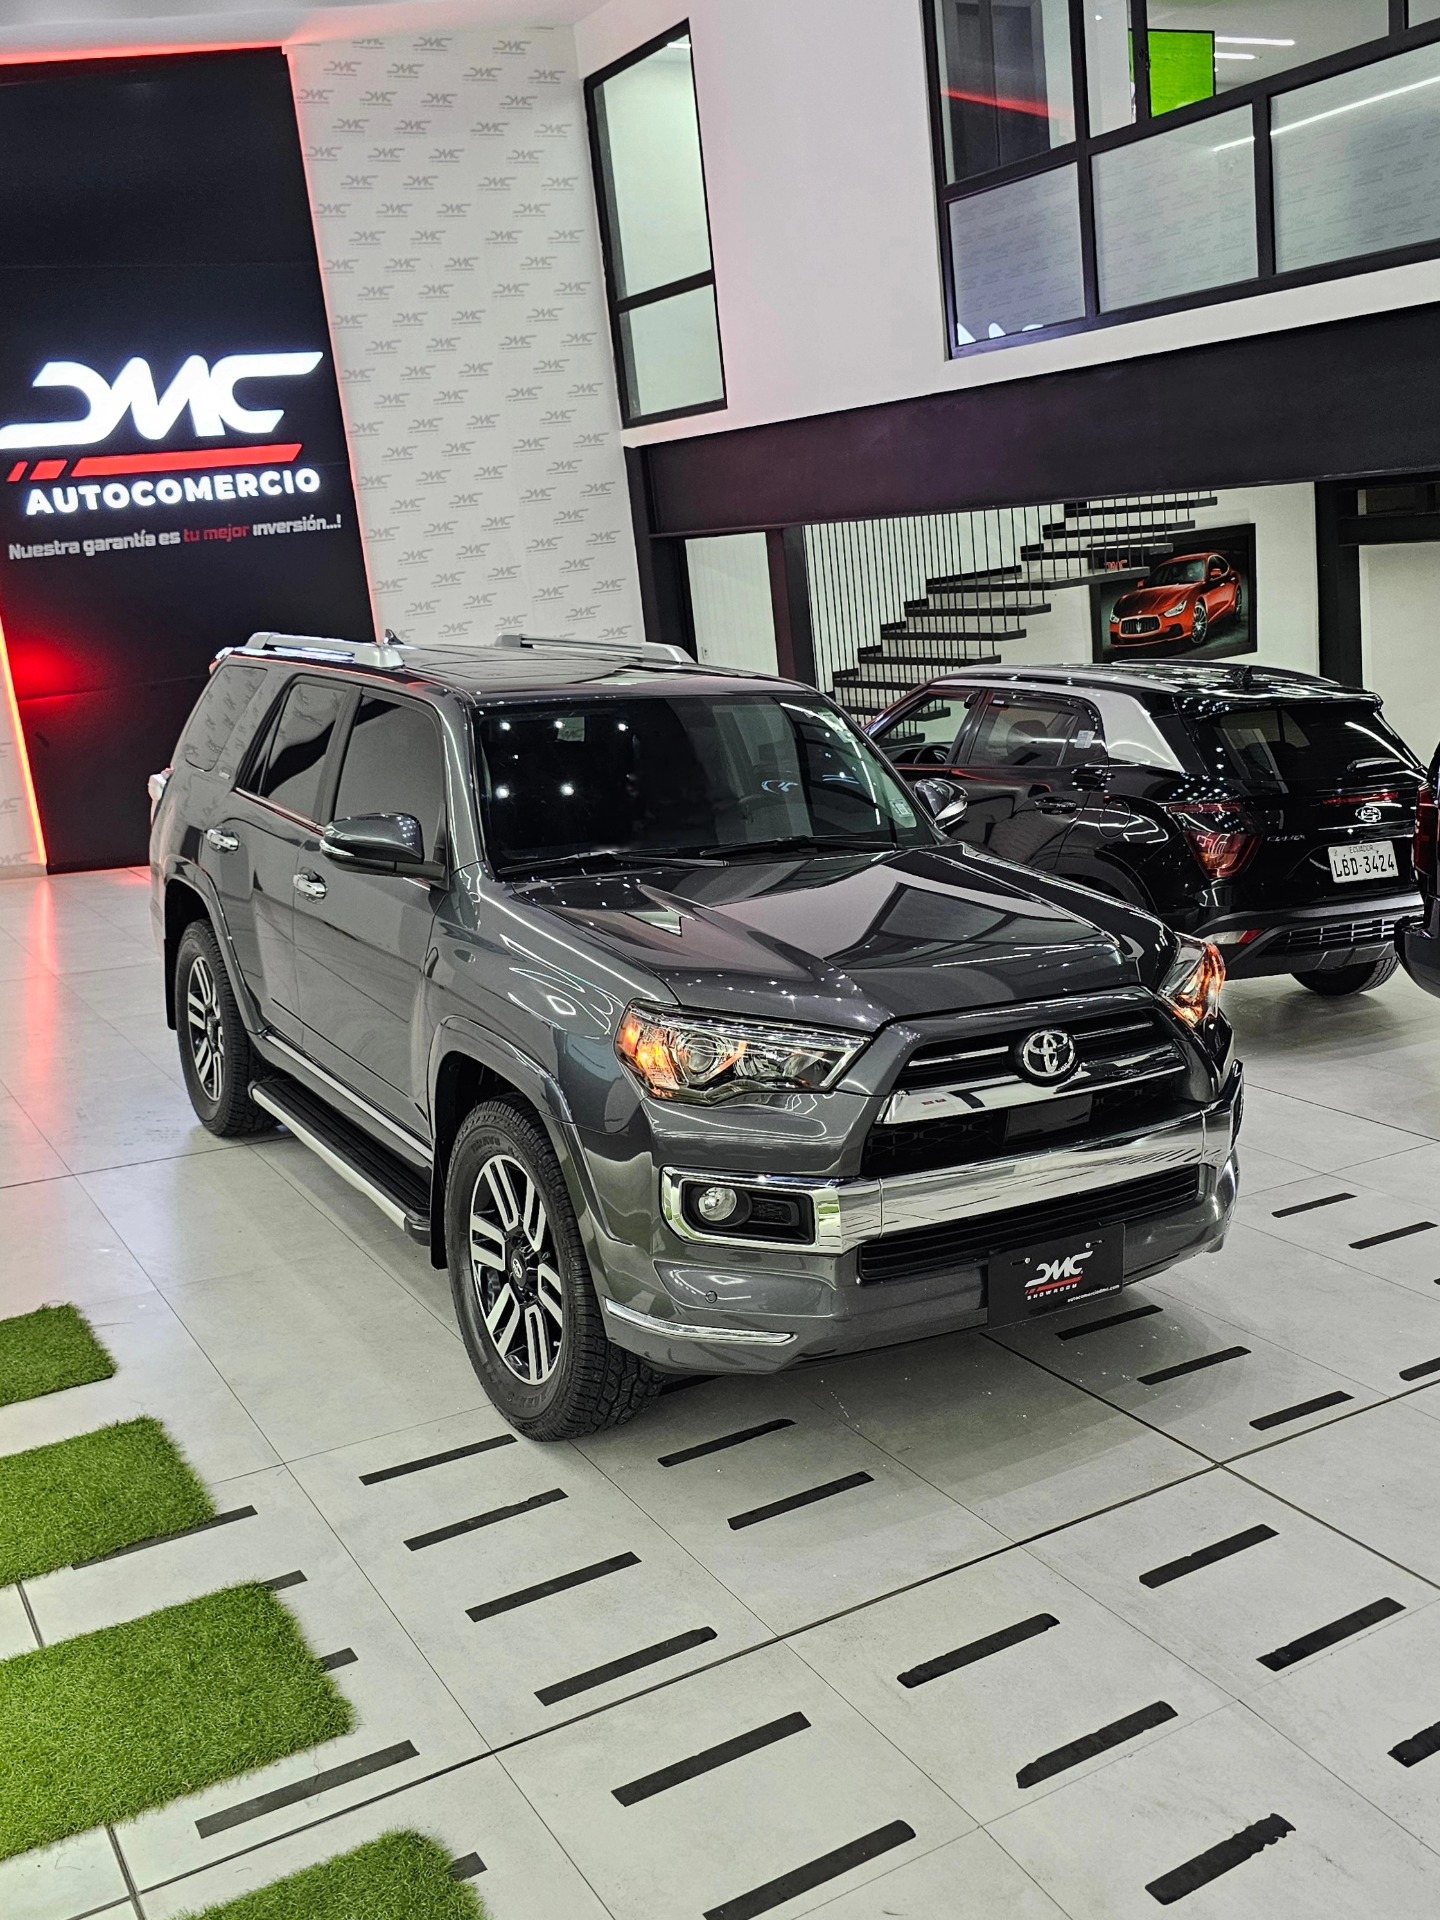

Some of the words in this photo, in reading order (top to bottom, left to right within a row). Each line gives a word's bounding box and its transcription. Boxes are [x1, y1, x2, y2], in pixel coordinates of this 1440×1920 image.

[412, 36, 452, 48] DMC
[492, 40, 531, 51] DMC
[324, 61, 362, 72] DMC
[387, 64, 424, 74] DMC
[463, 67, 502, 78] DMC
[528, 70, 566, 80] DMC
[297, 89, 334, 100] DMC
[360, 91, 397, 102] DMC
[421, 93, 457, 104] DMC
[499, 96, 538, 106] DMC
[332, 118, 370, 129] DMC
[394, 120, 431, 130] DMC
[470, 122, 510, 132] DMC
[535, 124, 571, 133] DMC
[307, 146, 342, 157] DMC
[368, 148, 405, 158] DMC
[428, 148, 464, 159] DMC
[507, 150, 544, 160] DMC
[340, 175, 378, 186] DMC
[403, 176, 438, 186] DMC
[478, 177, 516, 187] DMC
[541, 177, 578, 187] DMC
[316, 204, 351, 214] DMC
[376, 204, 412, 214] DMC
[436, 204, 471, 214] DMC
[513, 204, 550, 213] DMC
[349, 231, 386, 242] DMC
[410, 230, 446, 240] DMC
[485, 230, 522, 240] DMC
[548, 230, 584, 240] DMC
[324, 259, 358, 270] DMC
[384, 258, 420, 268] DMC
[444, 257, 479, 268] DMC
[520, 256, 557, 266] DMC
[358, 286, 394, 296] DMC
[418, 284, 454, 295] DMC
[492, 283, 530, 294] DMC
[554, 282, 590, 292] DMC
[392, 312, 428, 323] DMC
[452, 310, 486, 321] DMC
[526, 308, 564, 319] DMC
[332, 314, 368, 325] DMC
[426, 337, 461, 348] DMC
[498, 335, 536, 346] DMC
[560, 332, 597, 343] DMC
[366, 339, 402, 351] DMC
[458, 362, 493, 374] DMC
[533, 359, 570, 370] DMC
[341, 368, 375, 380] DMC
[400, 365, 436, 377] DMC
[506, 386, 543, 398] DMC
[567, 383, 603, 394] DMC
[0, 351, 323, 449] DMC
[374, 393, 410, 404] DMC
[433, 390, 468, 401] DMC
[466, 414, 500, 426] DMC
[540, 409, 576, 421] DMC
[349, 422, 384, 434] DMC
[408, 418, 443, 430] DMC
[512, 437, 550, 449] DMC
[573, 432, 609, 444] DMC
[382, 446, 418, 458] DMC
[441, 441, 476, 453] DMC
[474, 465, 507, 477] DMC
[546, 459, 582, 472] DMC
[357, 475, 392, 486] DMC
[416, 470, 451, 482] DMC
[26, 468, 320, 515] AUTOCOMERCIO
[520, 487, 556, 500] DMC
[580, 482, 616, 494] DMC
[390, 498, 425, 510] DMC
[448, 492, 483, 505] DMC
[553, 508, 588, 521] DMC
[481, 515, 514, 528] DMC
[365, 526, 400, 539] DMC
[424, 521, 458, 534] DMC
[586, 530, 621, 542] DMC
[9, 540, 80, 560] Nuestra
[83, 529, 156, 557] garantía
[159, 531, 181, 545] es
[184, 529, 200, 543] tu
[204, 524, 249, 542] mejor
[526, 536, 563, 549] DMC
[456, 543, 490, 556] DMC
[398, 549, 433, 562] DMC
[560, 557, 594, 570] DMC
[488, 565, 521, 578] DMC
[431, 571, 466, 584] DMC
[372, 578, 408, 591] DMC
[592, 578, 626, 591] DMC
[532, 585, 569, 598] DMC
[464, 592, 497, 606] DMC
[405, 600, 440, 613] DMC
[565, 605, 601, 618] DMC
[496, 614, 527, 627] DMC
[438, 621, 473, 634] DMC
[598, 625, 632, 638] DMC
[1349, 845, 1374, 853] ECUADOR
[1333, 854, 1394, 877] LBD-3424
[1025, 1251, 1093, 1287] DMC
[1027, 1284, 1077, 1300] SHOWROOM
